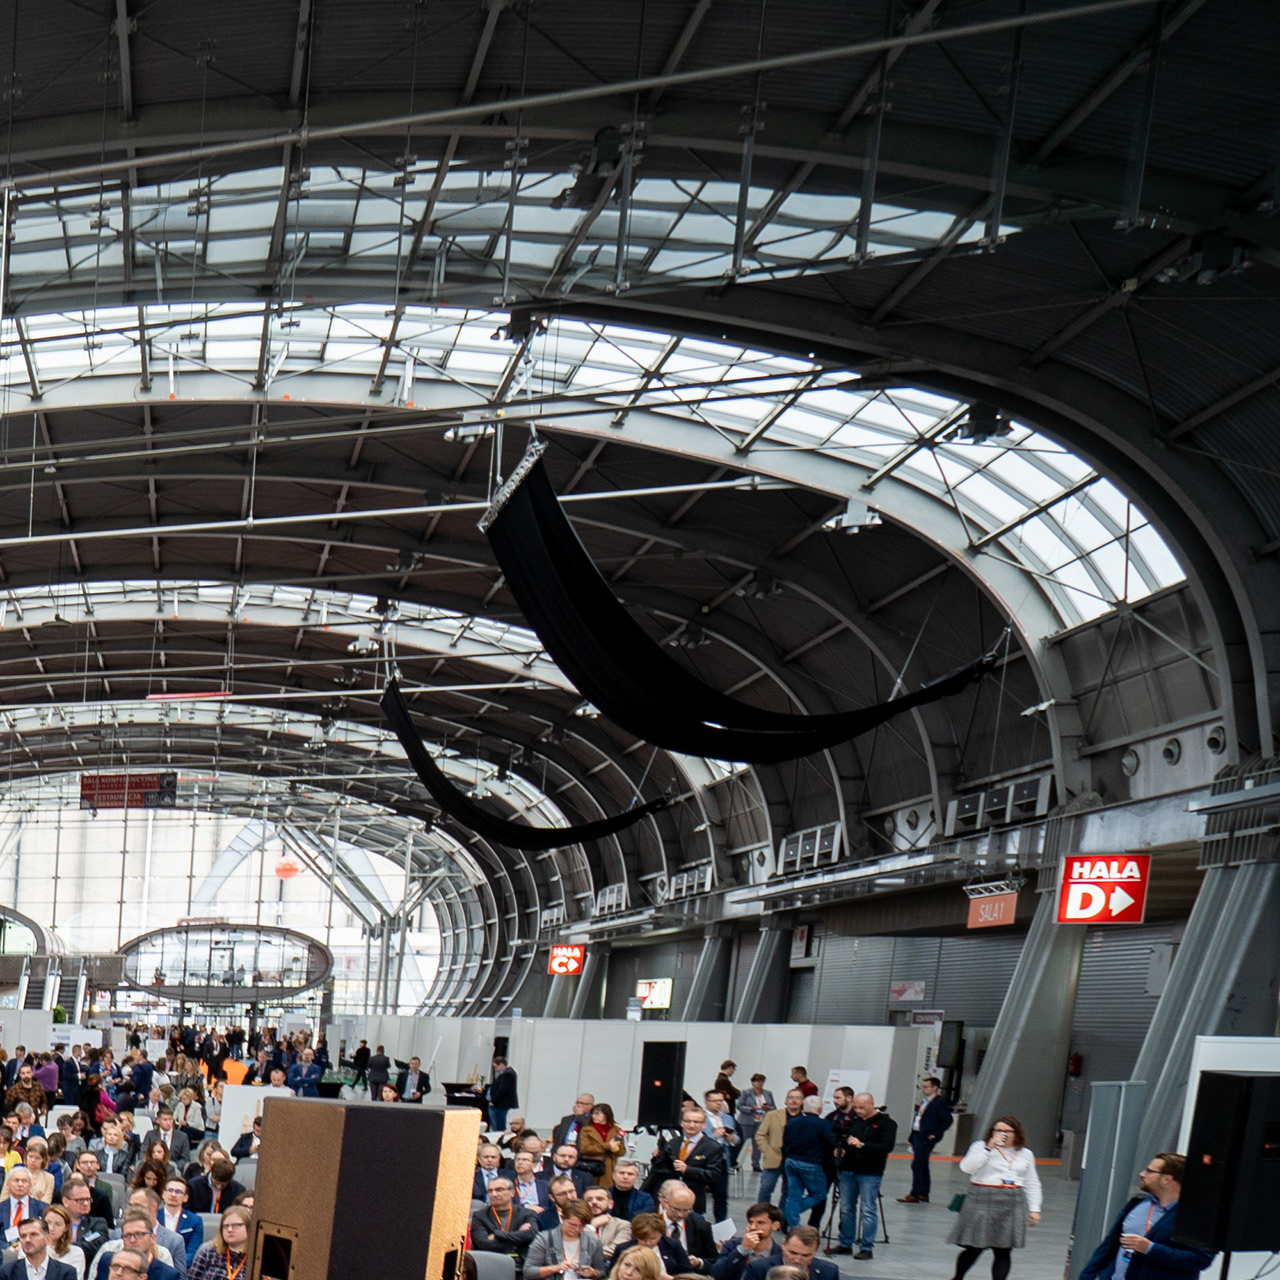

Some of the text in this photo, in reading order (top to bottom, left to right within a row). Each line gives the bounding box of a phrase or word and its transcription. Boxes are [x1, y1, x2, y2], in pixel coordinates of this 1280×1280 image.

[1071, 860, 1141, 879] HALA
[1065, 883, 1106, 919] D
[553, 946, 581, 956] HALA
[551, 956, 569, 973] C
